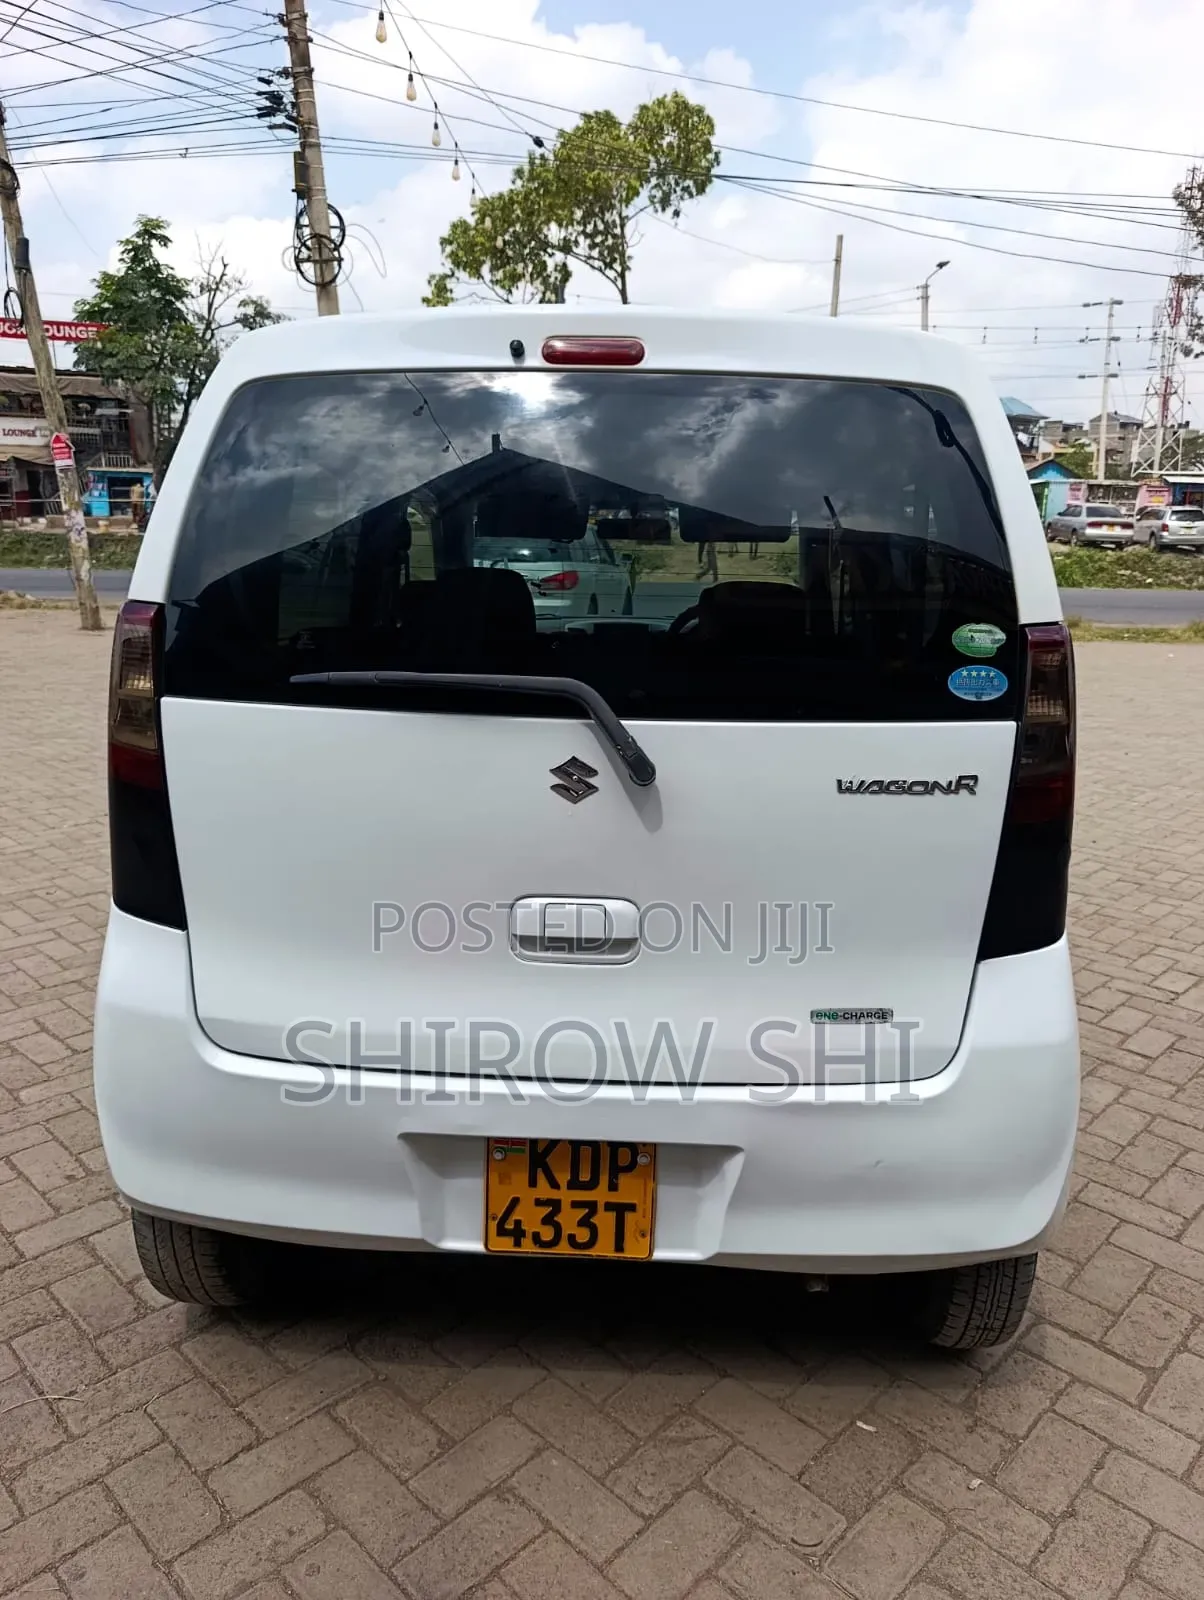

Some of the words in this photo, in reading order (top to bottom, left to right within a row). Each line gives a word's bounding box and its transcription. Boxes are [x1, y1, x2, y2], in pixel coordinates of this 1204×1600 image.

[43, 325, 97, 339] OUNGE
[2, 428, 37, 438] LOUNGE
[528, 1139, 639, 1192] KDP
[496, 1196, 637, 1253] 433T
